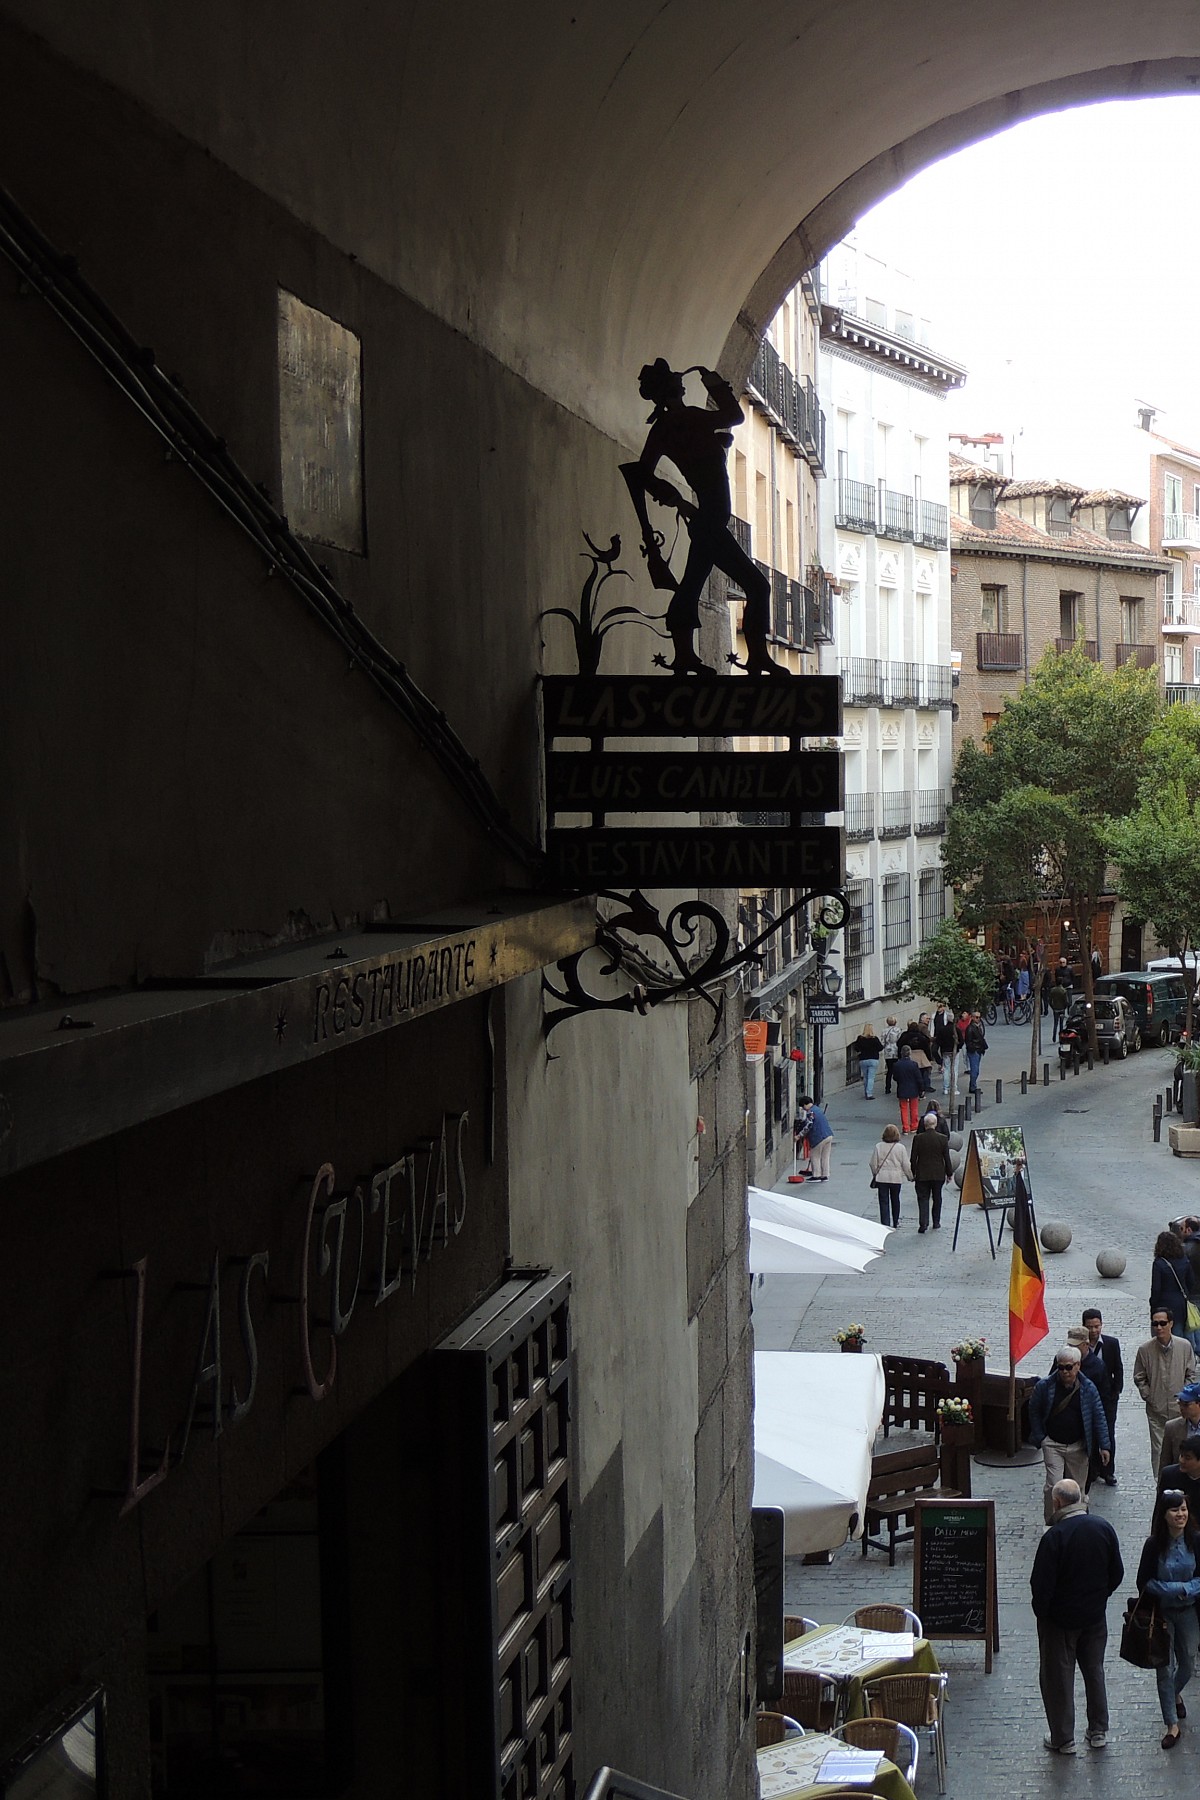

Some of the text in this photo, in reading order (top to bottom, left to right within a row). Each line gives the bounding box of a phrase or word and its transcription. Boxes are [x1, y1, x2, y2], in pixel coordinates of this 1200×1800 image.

[557, 684, 825, 729] LAS CUEVAS
[312, 940, 477, 1044] RESTAURANTE
[118, 1246, 270, 1520] LAS
[934, 1526, 956, 1536] DAILY
